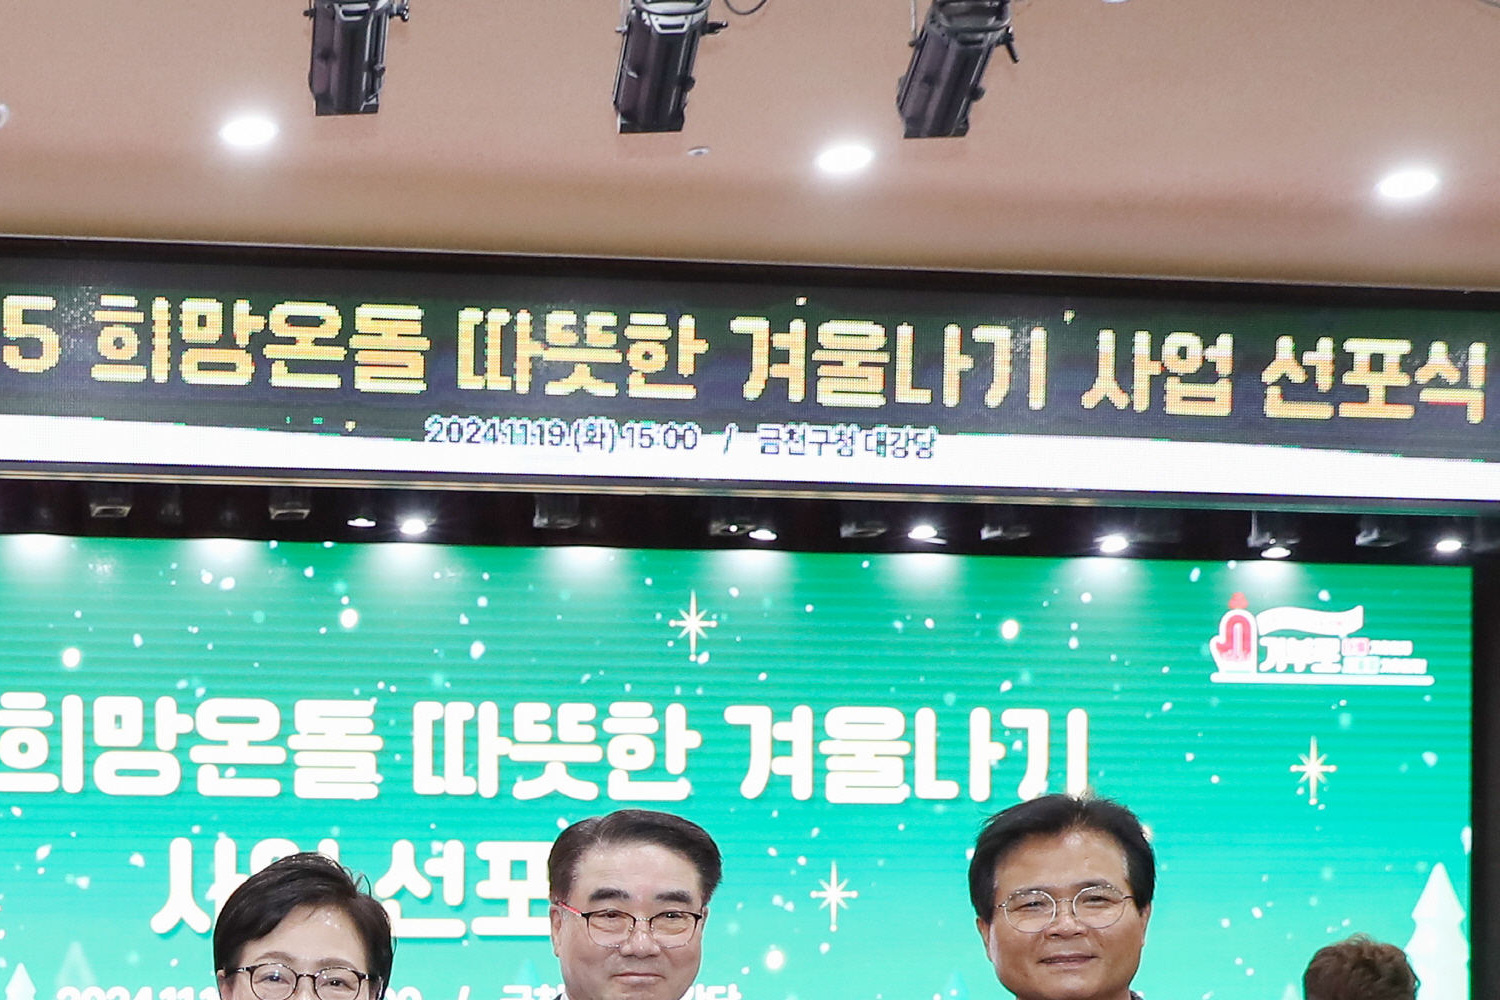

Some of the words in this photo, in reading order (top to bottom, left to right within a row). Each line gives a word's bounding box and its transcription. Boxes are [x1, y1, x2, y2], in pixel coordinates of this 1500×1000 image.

[90, 294, 431, 395] 희망온돌
[455, 306, 710, 399] 따뜻한
[729, 315, 1048, 411] 겨울나기
[1081, 328, 1235, 417] 사업
[1260, 334, 1488, 425] 선포식
[756, 422, 860, 458] 금천구청
[864, 424, 938, 460] 대강당
[411, 700, 702, 802] 따뜻한
[723, 704, 1090, 806] 겨울나기
